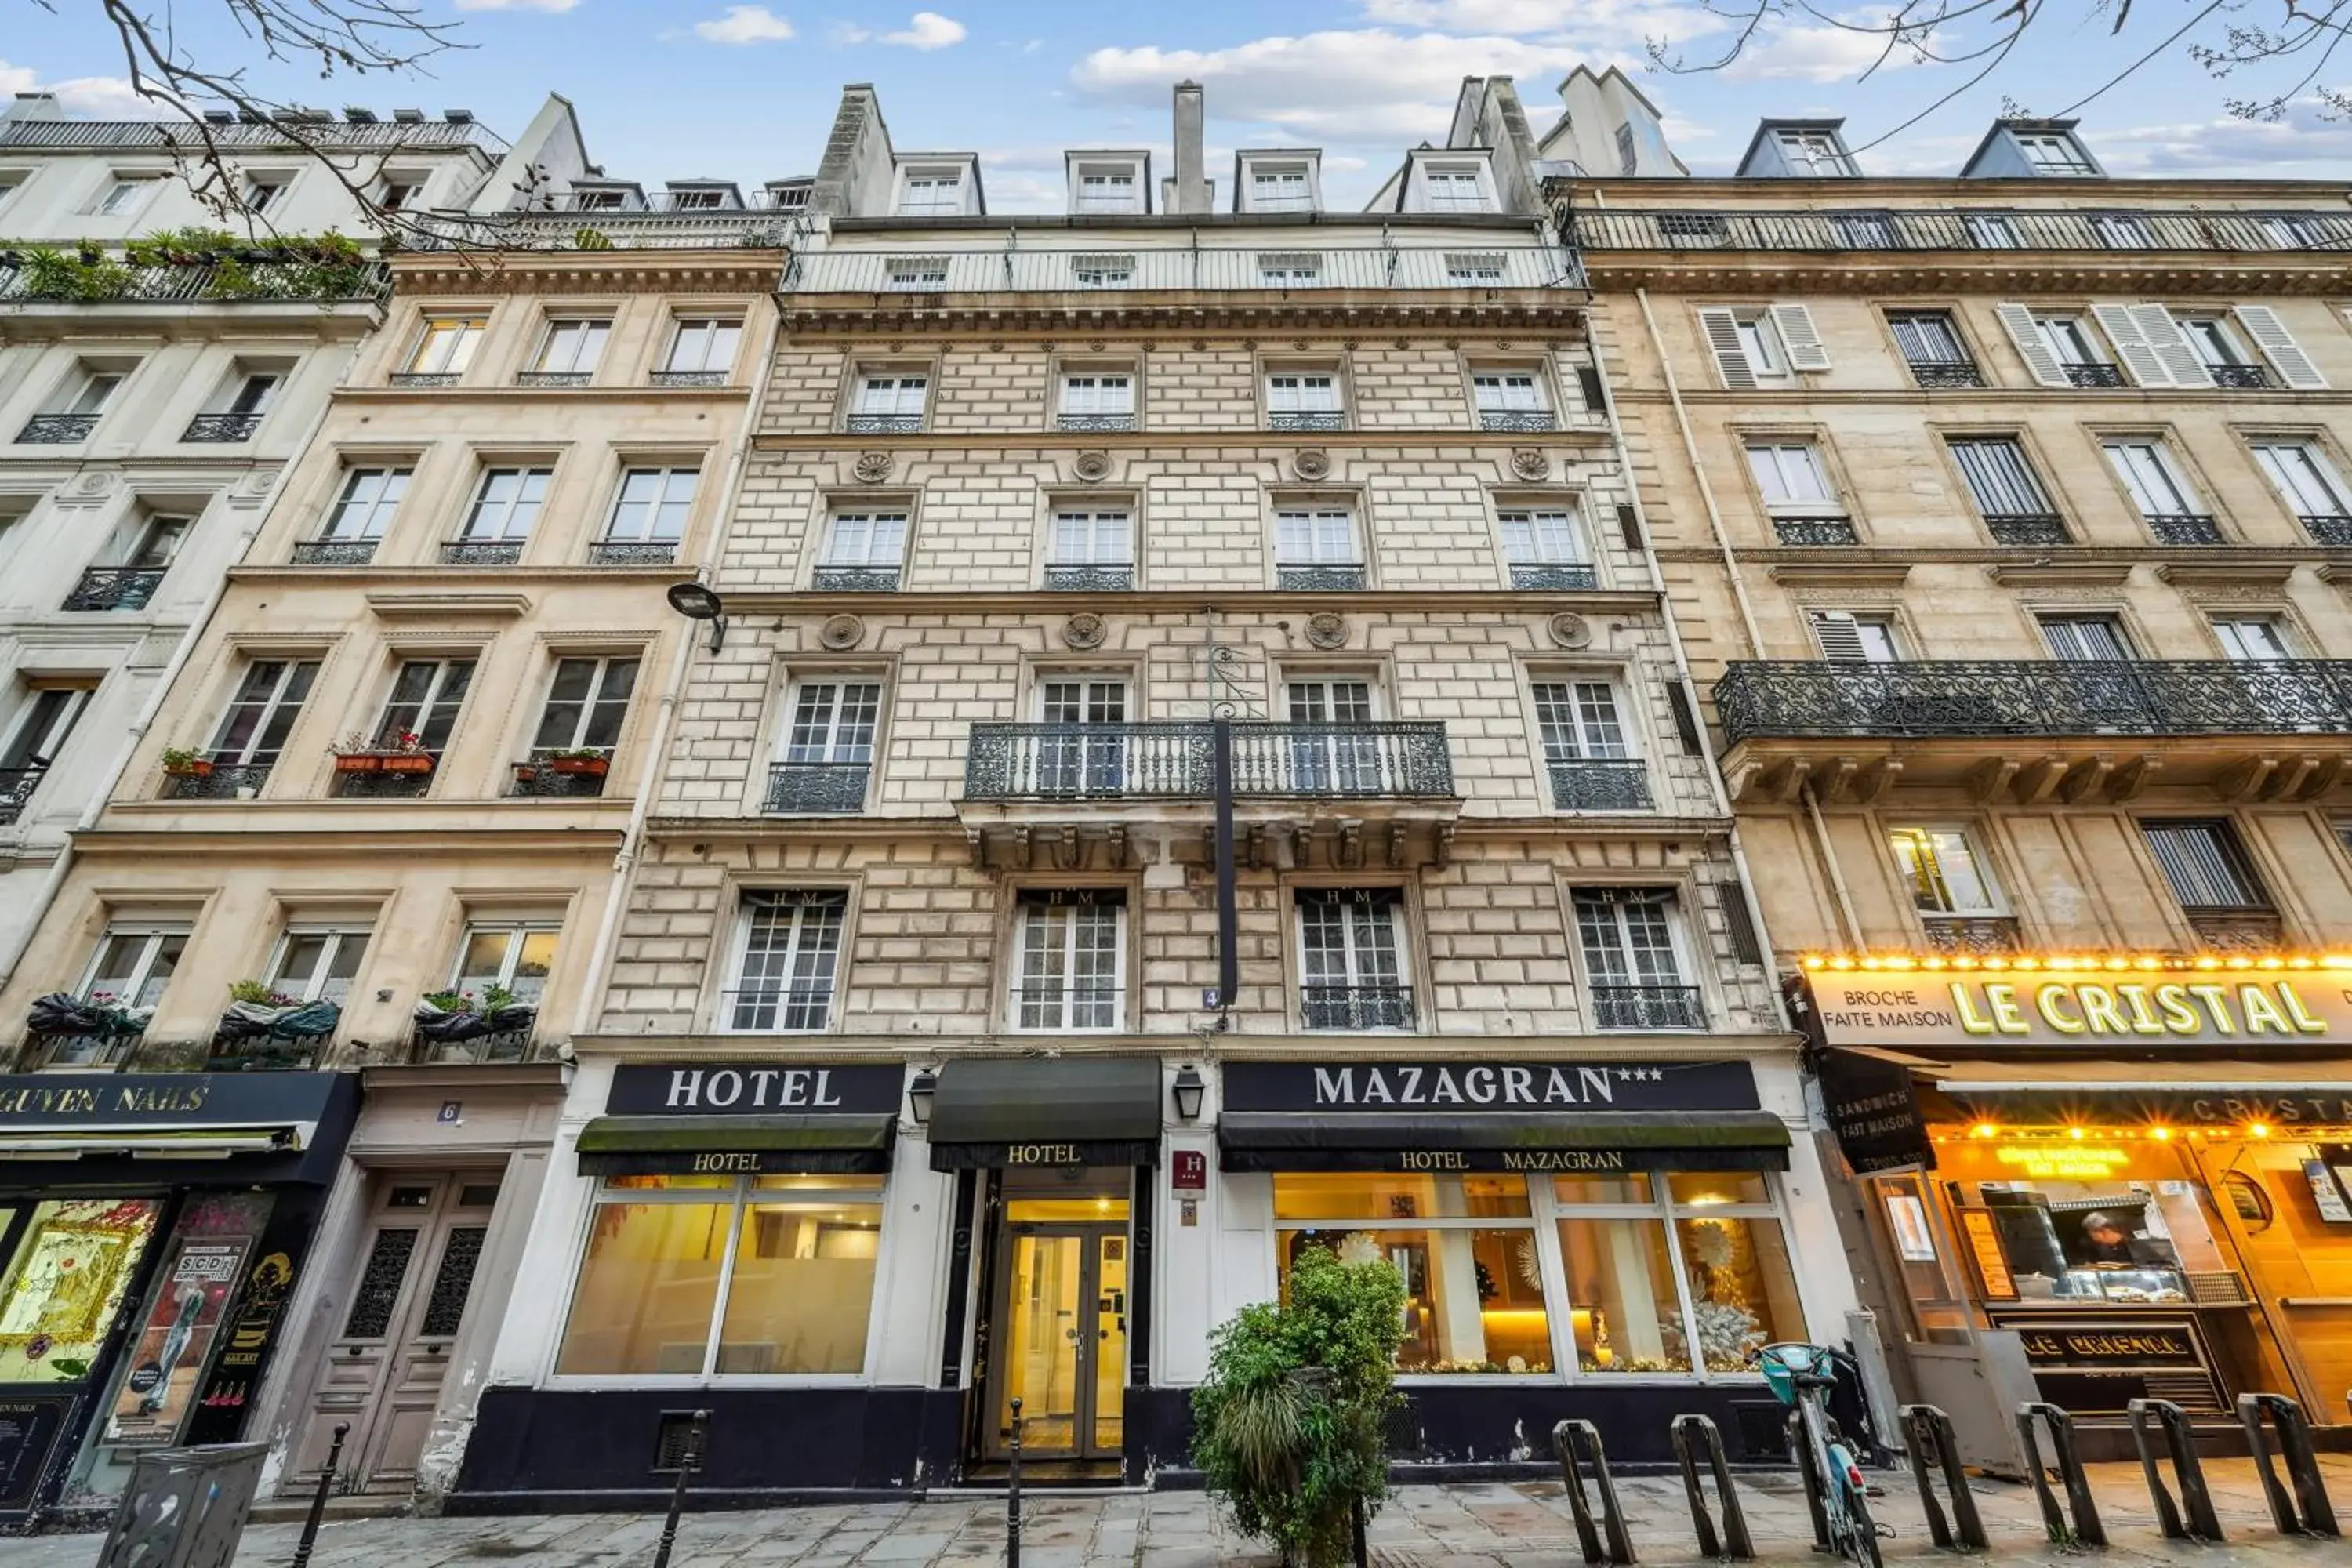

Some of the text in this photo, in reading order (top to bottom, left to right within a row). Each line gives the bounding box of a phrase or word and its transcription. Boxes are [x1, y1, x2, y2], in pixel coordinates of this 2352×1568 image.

[1327, 890, 1370, 904] H M
[1207, 990, 1218, 1006] 4
[1843, 990, 1918, 1006] BROCHE
[1948, 980, 2328, 1034] LE CRISTAL
[1823, 1011, 1953, 1027] FAITE MAISON
[664, 1069, 842, 1107] HOTEL
[1313, 1066, 1614, 1105] MAZAGRAN
[113, 1087, 205, 1112] NAILS
[444, 1103, 456, 1120] 6
[693, 1152, 762, 1171] HOTEL
[1008, 1144, 1082, 1163] HOTEL
[1400, 1151, 1624, 1170] HOTEL MAZAGRAN
[1186, 1156, 1202, 1171] H
[181, 1258, 220, 1269] SCD
[2066, 1335, 2190, 1355] CRISTAL
